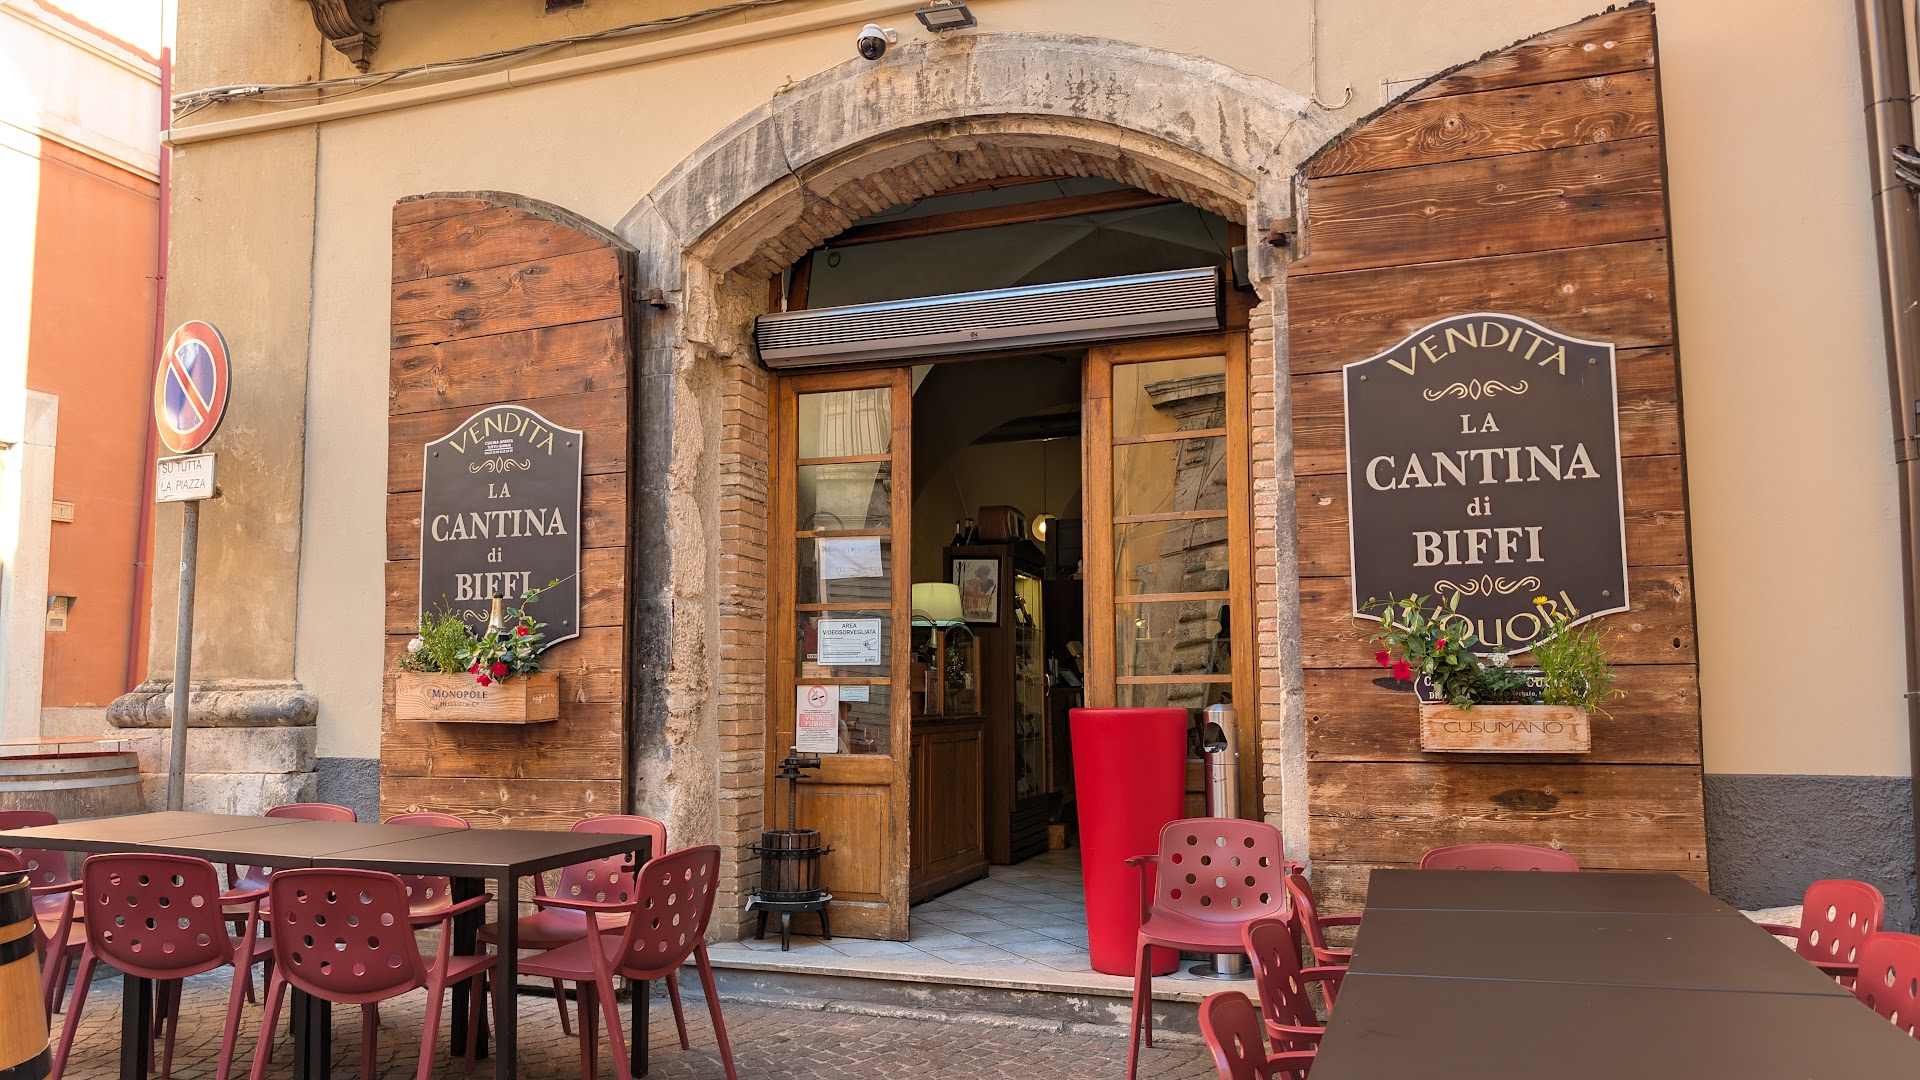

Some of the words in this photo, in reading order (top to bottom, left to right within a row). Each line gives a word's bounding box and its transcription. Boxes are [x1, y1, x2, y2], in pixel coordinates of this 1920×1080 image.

[1386, 321, 1566, 375] VENDITA
[1460, 412, 1500, 434] LA
[449, 412, 553, 456] VENDITA
[162, 461, 173, 473] SU
[177, 460, 202, 472] TUTTA
[1366, 443, 1600, 491] CANTINA
[162, 481, 172, 492] LA
[176, 479, 206, 491] PIAZZA
[488, 482, 511, 499] LA
[1466, 496, 1492, 516] di
[431, 507, 567, 542] CANTINA
[487, 547, 502, 562] di
[1412, 526, 1545, 567] BIFFI
[455, 571, 532, 601] BIFFI
[432, 689, 488, 699] MONOPOLE
[1443, 721, 1564, 734] CUSUMANO
